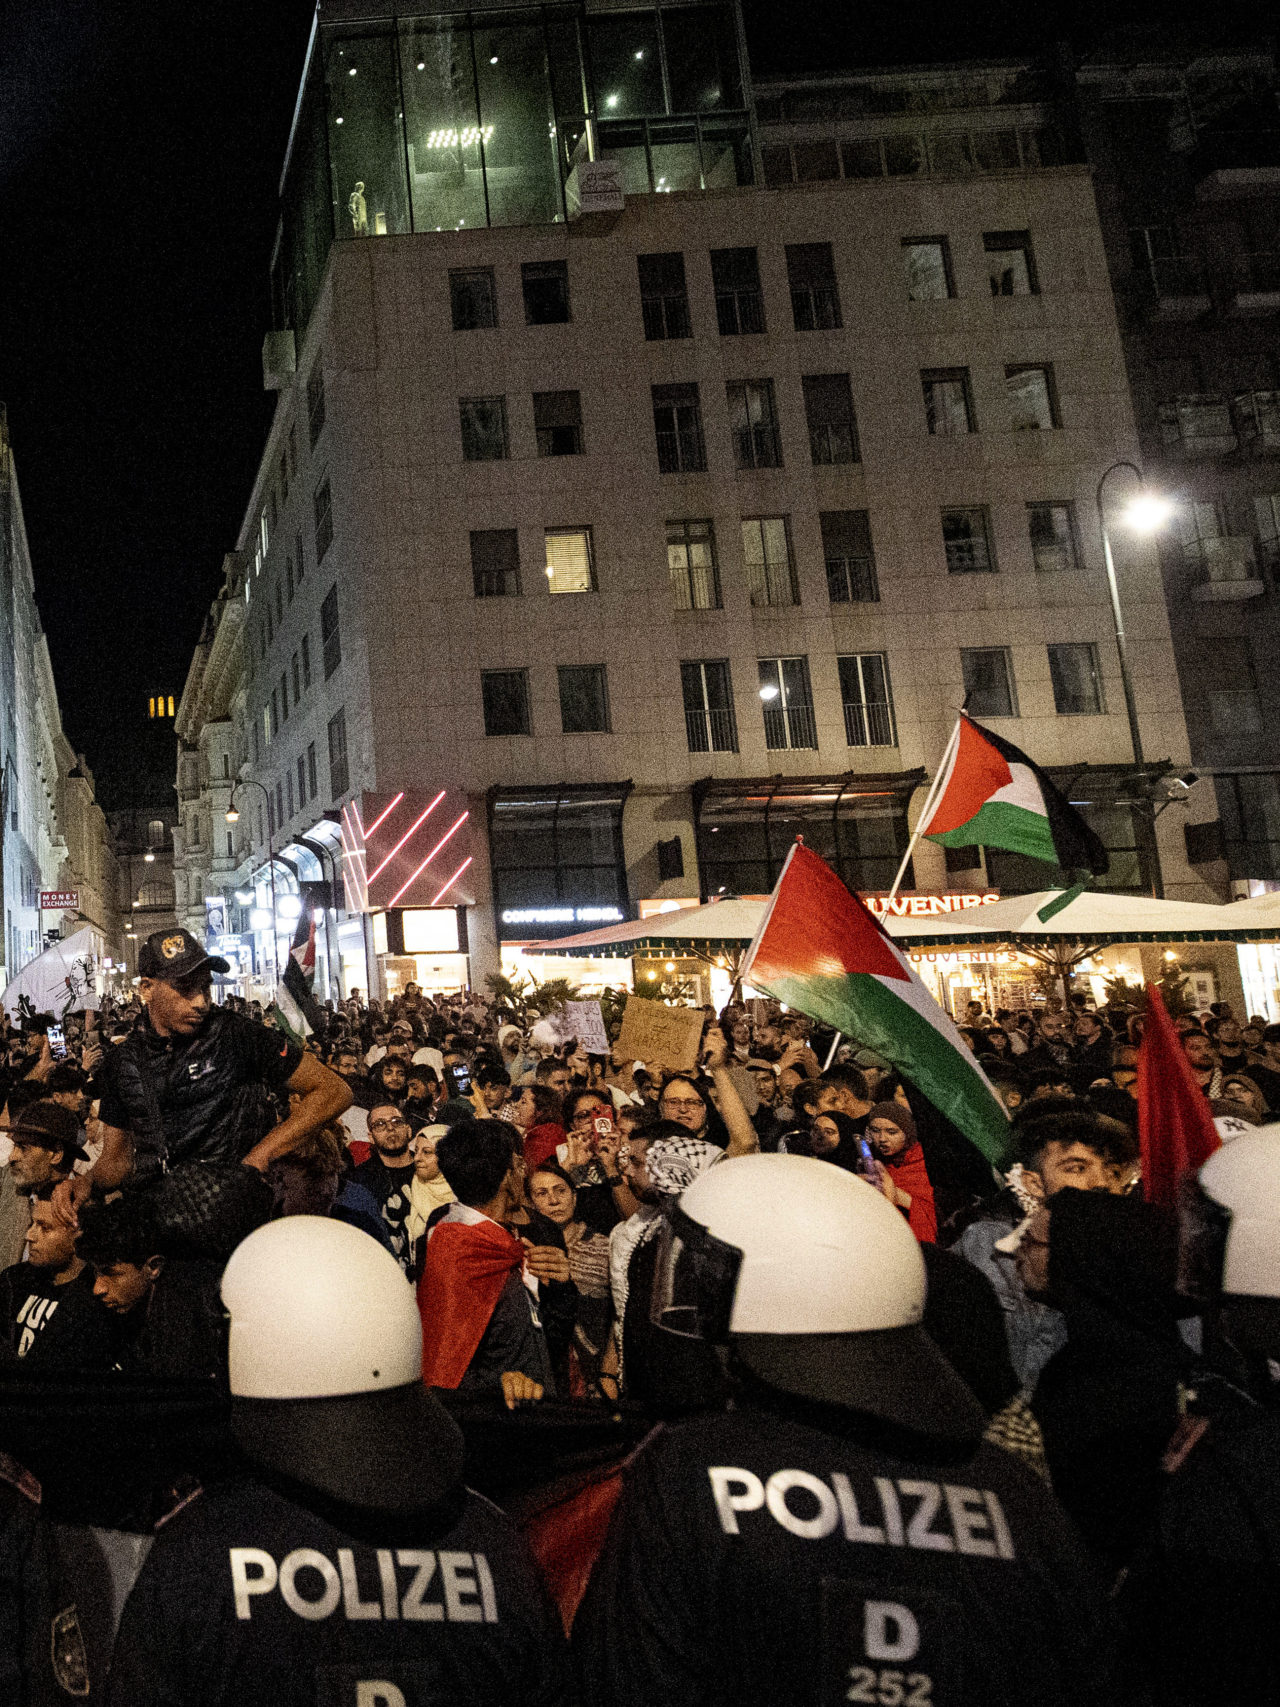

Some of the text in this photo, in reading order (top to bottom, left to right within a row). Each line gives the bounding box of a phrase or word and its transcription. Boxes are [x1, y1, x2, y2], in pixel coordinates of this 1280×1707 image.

[43, 893, 78, 901] MONEY
[862, 894, 1000, 916] UVENIRS
[909, 951, 1019, 963] OUVENIRS
[707, 1466, 1016, 1560] POLIZEI
[229, 1547, 499, 1624] POLIZEI
[864, 1600, 920, 1662] D
[847, 1665, 934, 1707] 252
